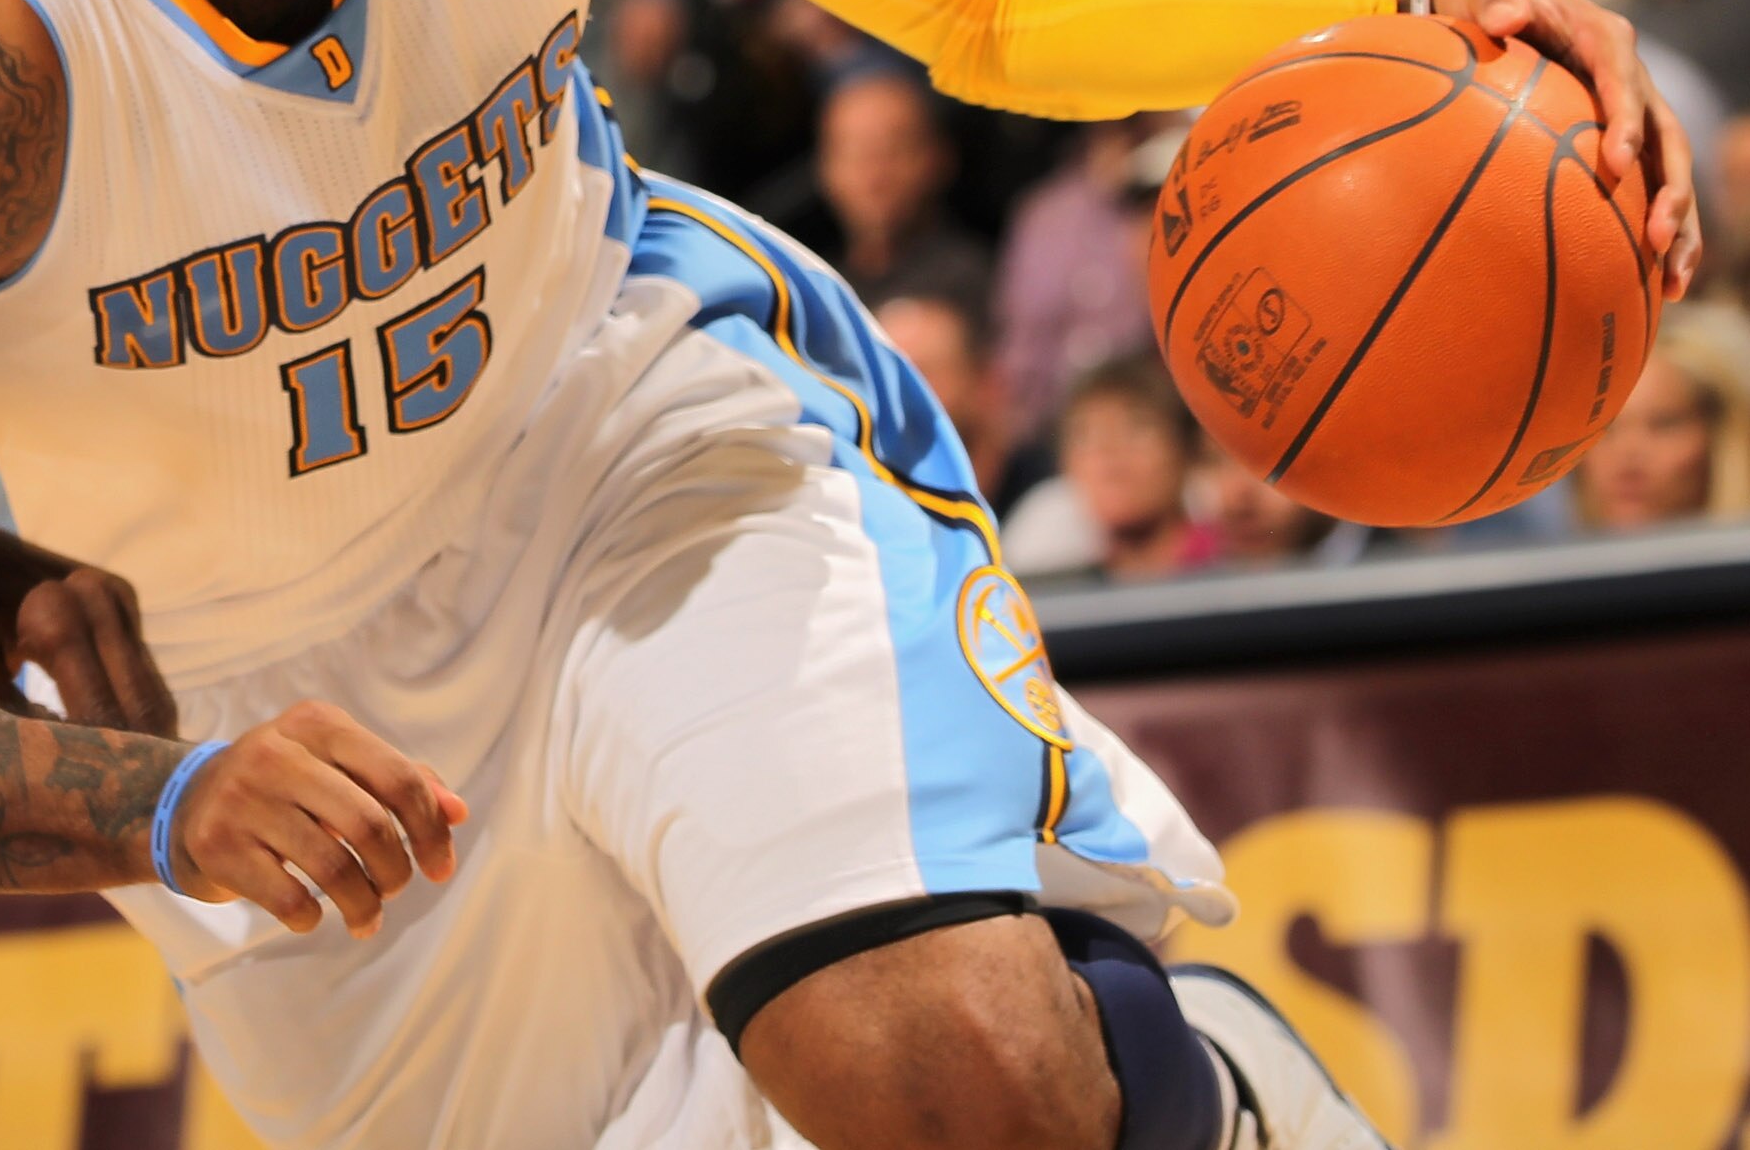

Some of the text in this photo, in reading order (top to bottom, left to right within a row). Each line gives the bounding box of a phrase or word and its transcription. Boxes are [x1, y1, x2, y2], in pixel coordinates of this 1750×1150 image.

[310, 34, 354, 91] D
[88, 9, 580, 370] NUGGETS
[279, 264, 493, 478] 15
